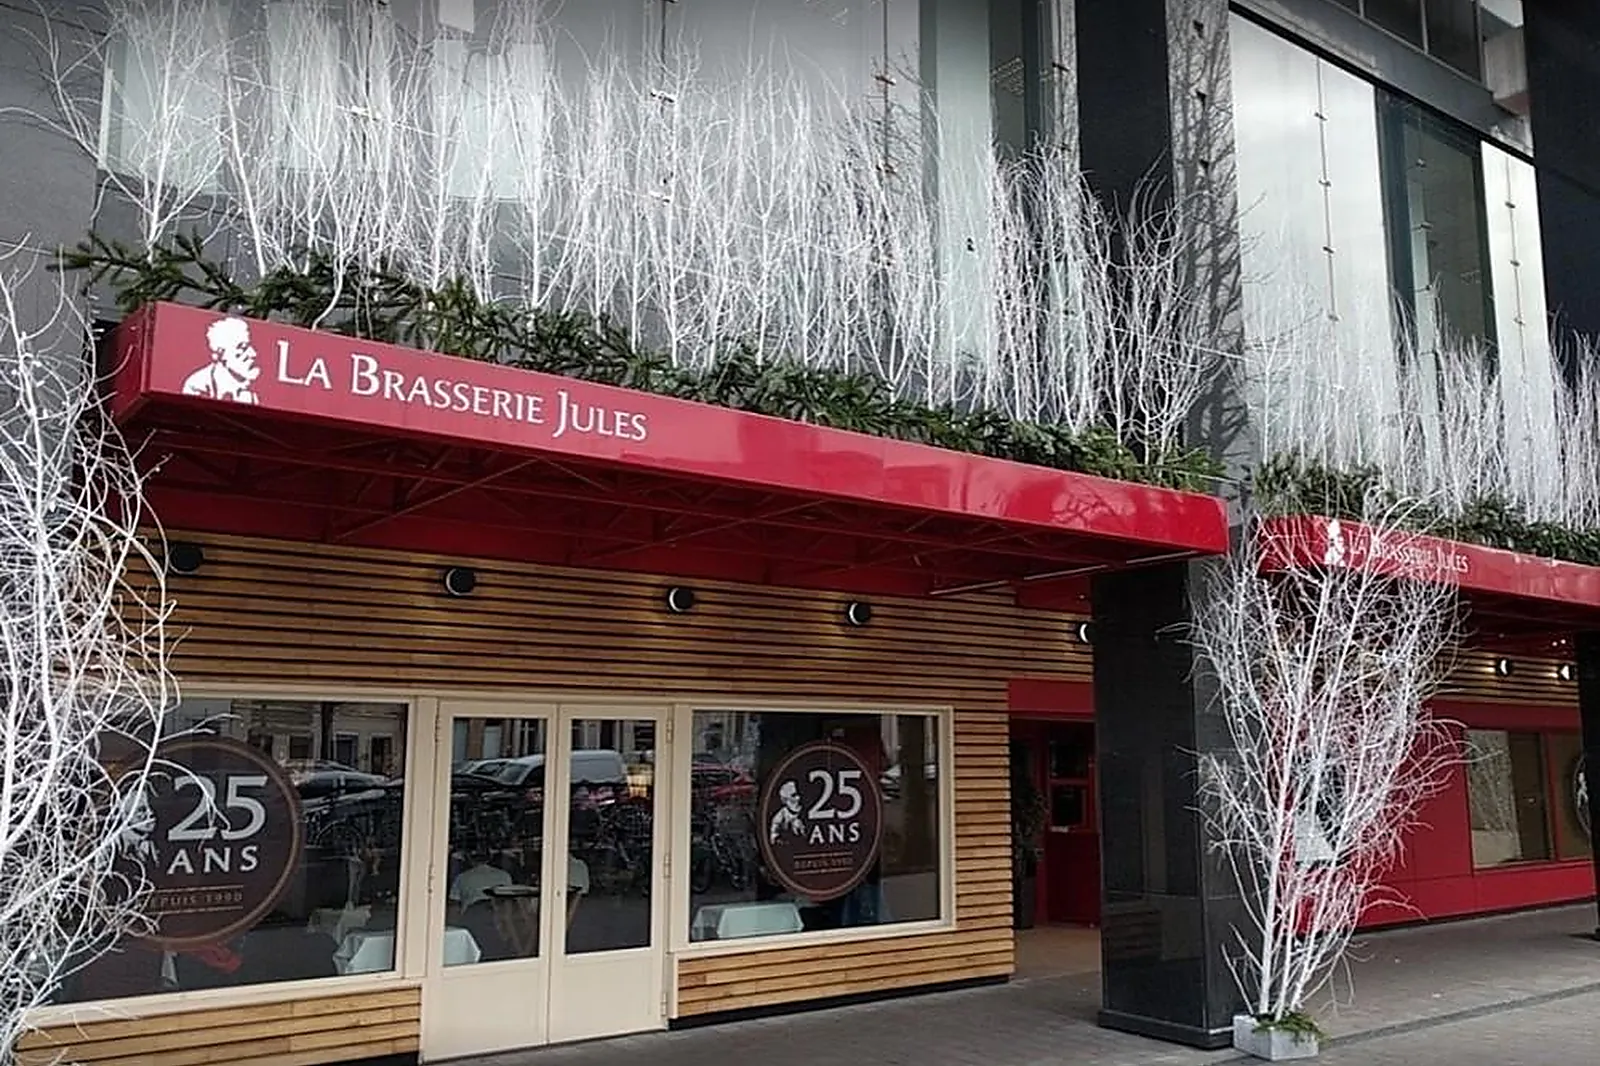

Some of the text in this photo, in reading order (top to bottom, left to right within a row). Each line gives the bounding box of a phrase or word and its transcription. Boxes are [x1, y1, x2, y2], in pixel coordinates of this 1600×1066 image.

[167, 775, 269, 842] 25
[807, 769, 863, 820] 25
[808, 822, 861, 845] ANS
[166, 845, 259, 876] ANS
